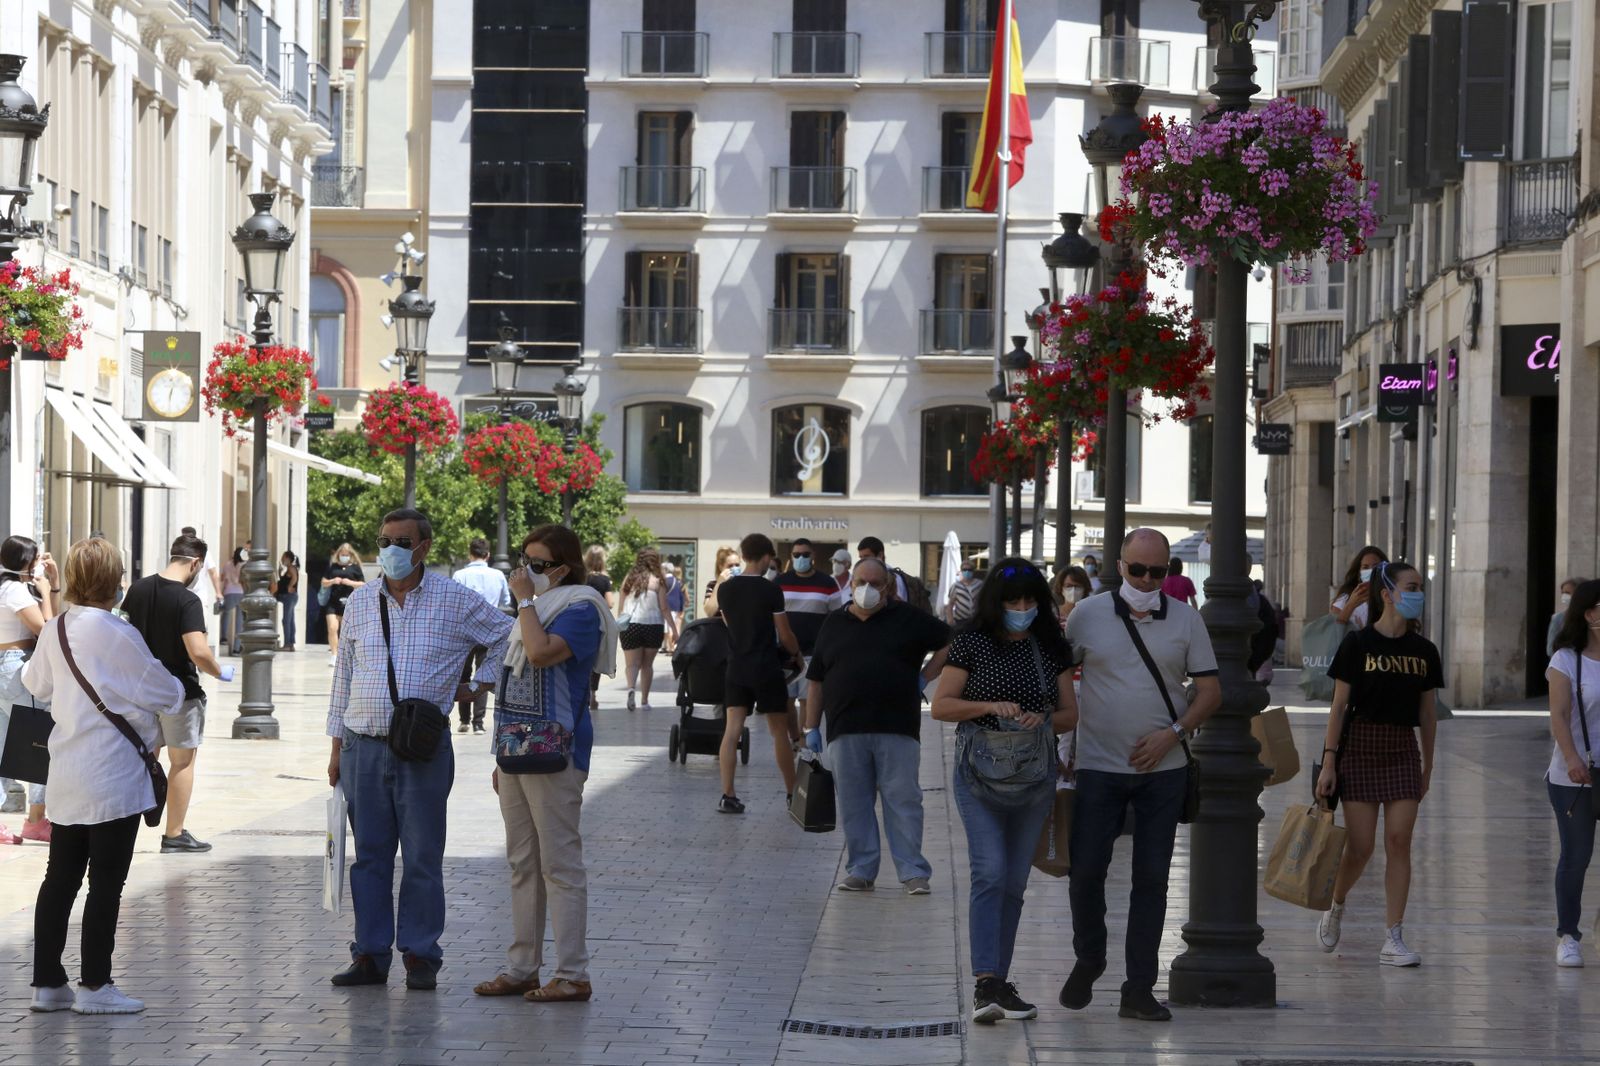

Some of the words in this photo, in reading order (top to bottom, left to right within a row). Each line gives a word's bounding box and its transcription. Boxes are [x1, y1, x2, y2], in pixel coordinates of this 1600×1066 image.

[1380, 375, 1422, 390] Etam
[1260, 430, 1289, 441] NYX
[770, 516, 849, 530] stradivarius
[1302, 655, 1334, 668] PULL
[1364, 653, 1428, 677] BONITA
